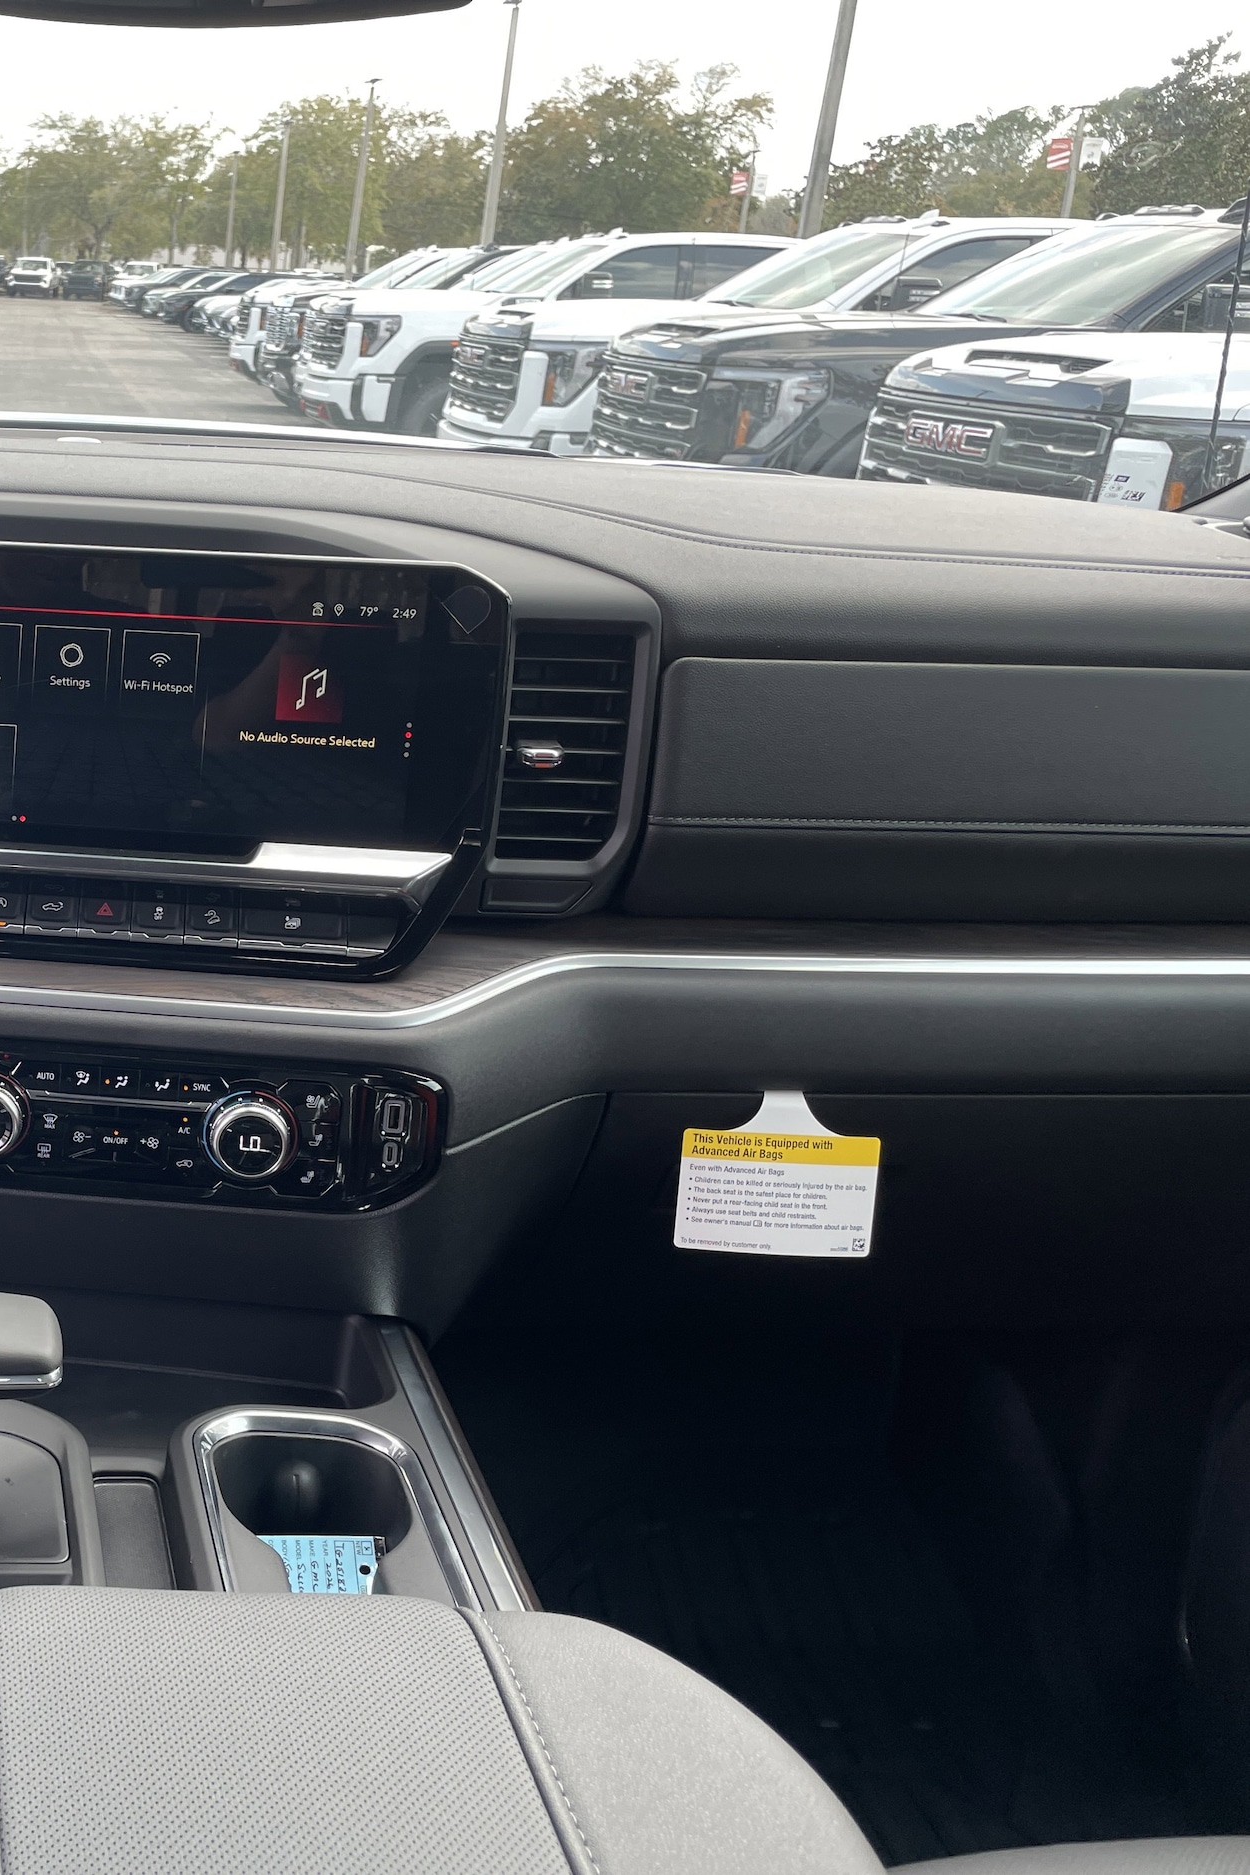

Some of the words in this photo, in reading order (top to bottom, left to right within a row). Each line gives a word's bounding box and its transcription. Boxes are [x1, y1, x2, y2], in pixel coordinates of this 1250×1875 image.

[904, 418, 993, 459] GMC
[359, 606, 379, 617] 79°
[392, 607, 417, 619] 2:49
[50, 675, 91, 690] Settings
[124, 679, 150, 690] Wi-Fi
[152, 681, 194, 694] Hotspot
[239, 731, 255, 742] No
[257, 732, 288, 744] Audio
[290, 733, 327, 746] Source
[329, 736, 376, 748] Selected
[36, 1071, 55, 1081] AUTO
[192, 1082, 211, 1093] SYNC
[178, 1126, 191, 1135] A/C
[103, 1136, 128, 1145] ON/OFF
[239, 1135, 261, 1151] LO
[694, 1133, 714, 1144] This
[716, 1134, 752, 1146] Vehicle
[754, 1137, 763, 1147] is
[765, 1138, 810, 1150] Equipped
[812, 1140, 833, 1150] with
[691, 1145, 740, 1157] Advanced
[742, 1148, 757, 1158] Air
[759, 1149, 783, 1161] Bags
[689, 1163, 706, 1171] Even
[723, 1166, 756, 1174] Advanced
[768, 1168, 785, 1177] Bags
[694, 1175, 721, 1184] Children
[746, 1179, 763, 1187] killed
[773, 1181, 801, 1190] seriously
[825, 1183, 833, 1191] by
[693, 1196, 710, 1204] Never
[729, 1199, 763, 1208] rear-facing
[775, 1191, 791, 1199] place
[691, 1206, 714, 1215] Always
[790, 1222, 822, 1230] information
[325, 1563, 333, 1589] 2026
